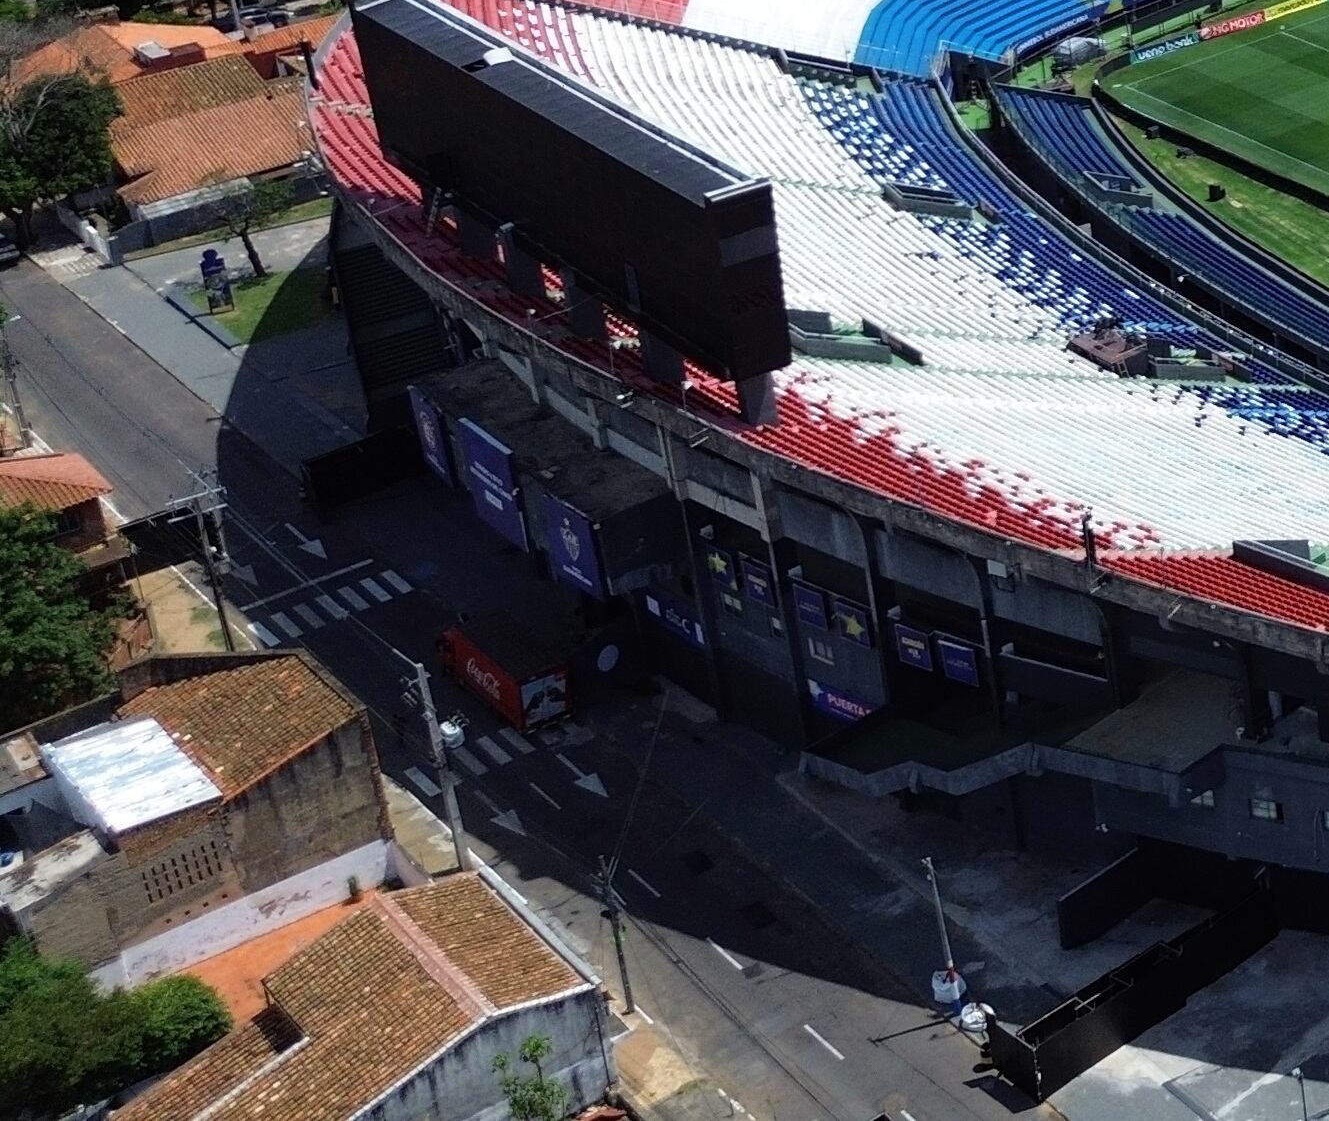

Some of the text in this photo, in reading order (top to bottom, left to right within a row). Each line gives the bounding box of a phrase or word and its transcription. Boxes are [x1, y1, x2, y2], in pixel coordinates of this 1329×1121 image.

[1230, 13, 1265, 30] MOTOR
[1138, 35, 1195, 60] ueno bank
[827, 693, 866, 719] PUERTA
